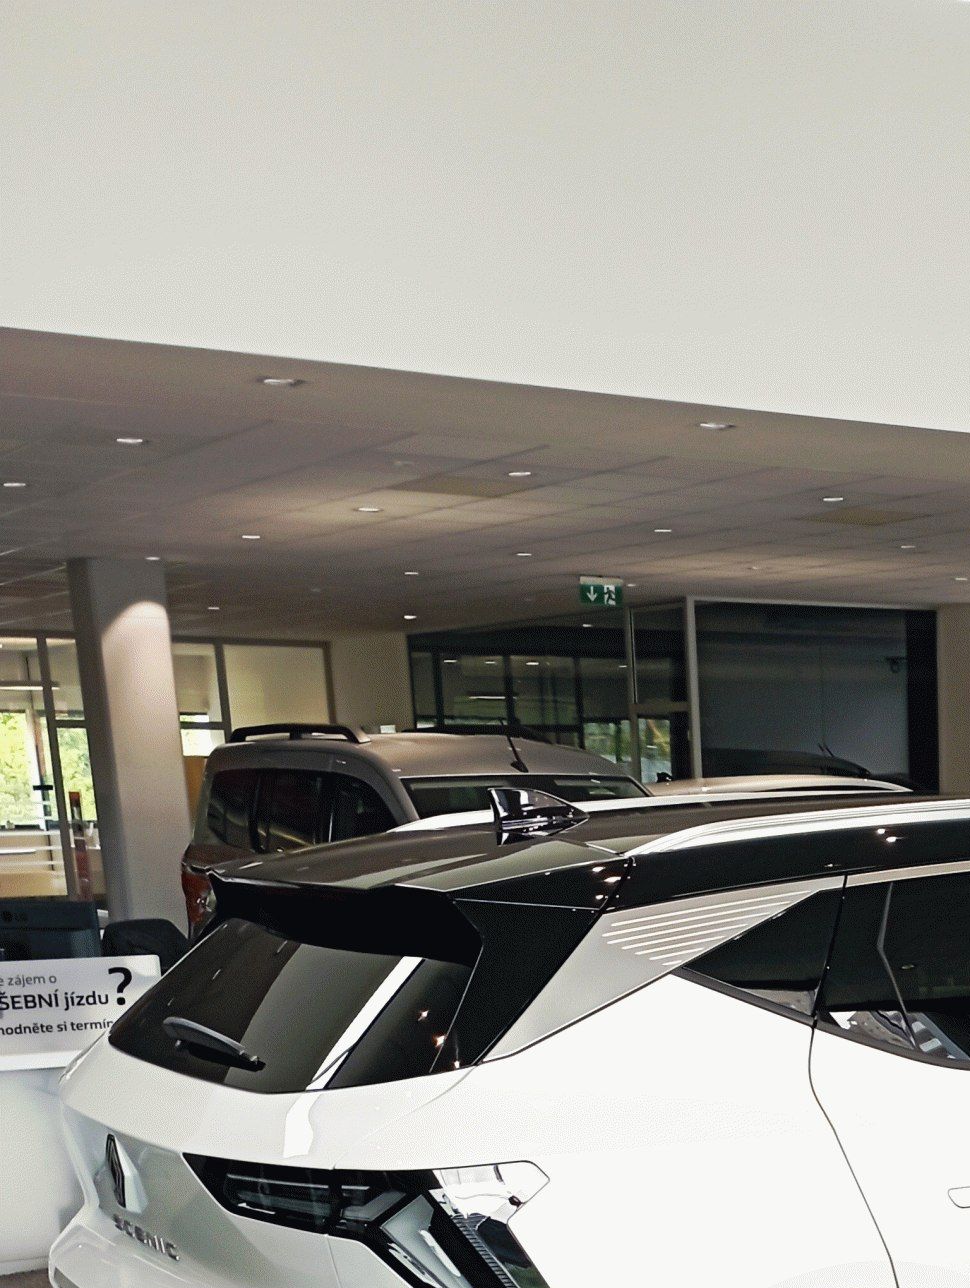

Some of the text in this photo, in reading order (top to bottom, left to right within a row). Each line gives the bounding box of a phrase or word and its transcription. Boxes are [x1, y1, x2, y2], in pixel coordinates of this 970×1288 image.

[8, 974, 46, 988] zájem
[48, 975, 57, 984] o
[64, 991, 109, 1011] jízdu
[56, 1021, 68, 1032] si
[113, 1213, 180, 1261] SCENIC
